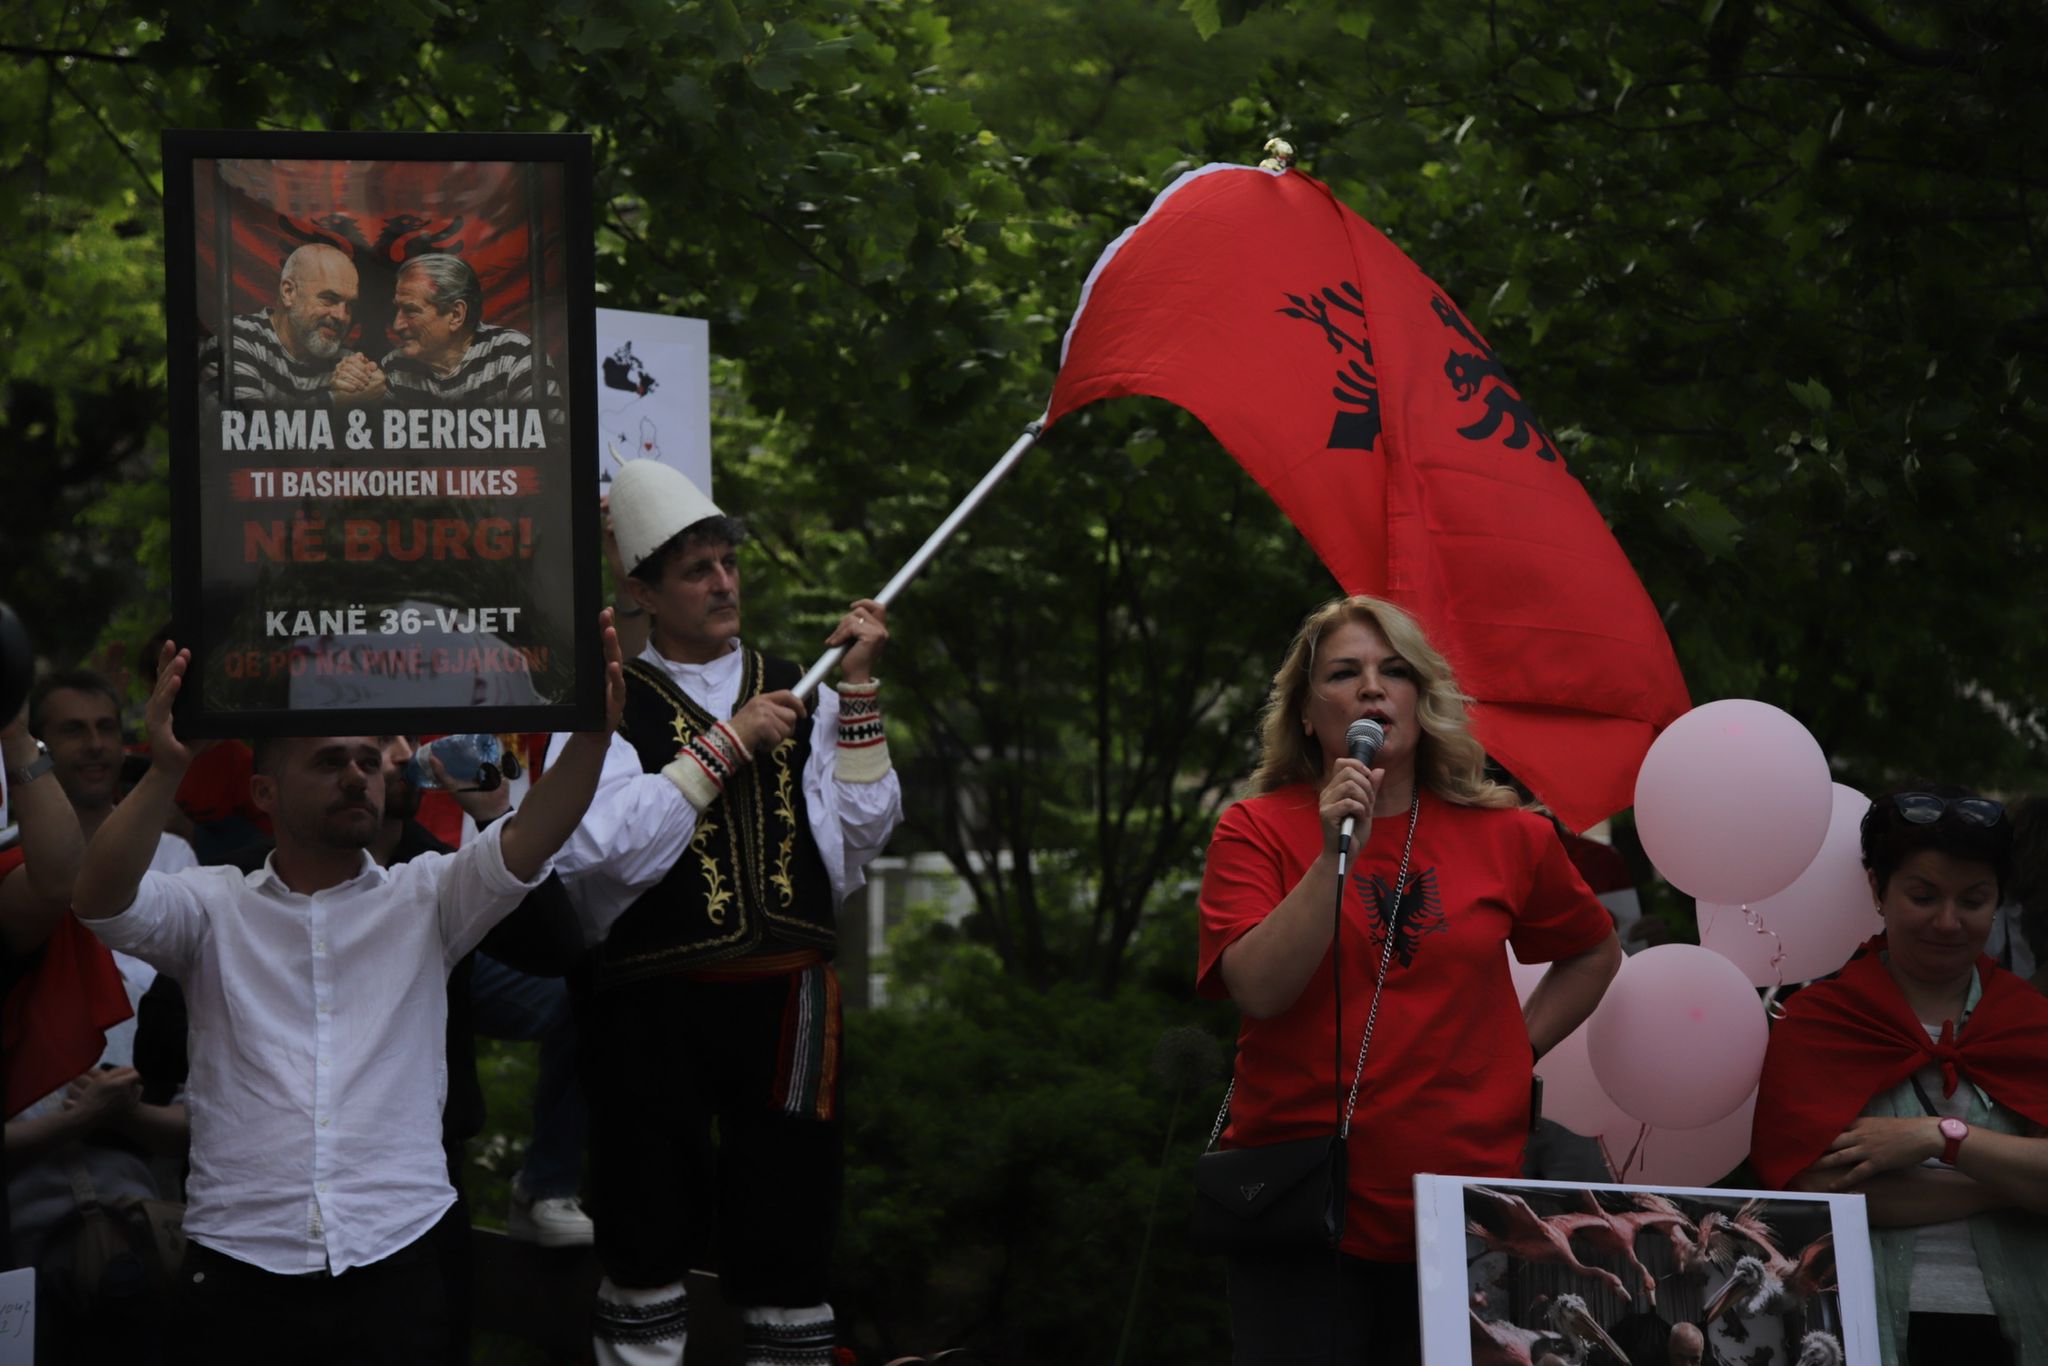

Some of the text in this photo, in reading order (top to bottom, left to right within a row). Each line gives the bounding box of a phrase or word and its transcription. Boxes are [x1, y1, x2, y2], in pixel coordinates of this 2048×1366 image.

[221, 408, 547, 451] RAMA & BERISHA
[250, 469, 518, 498] TI BASHKOHEN LIKES
[243, 510, 533, 563] NË BURG!
[265, 603, 521, 637] KANË 36-VJET
[270, 648, 308, 678] PO
[315, 648, 353, 676] NA
